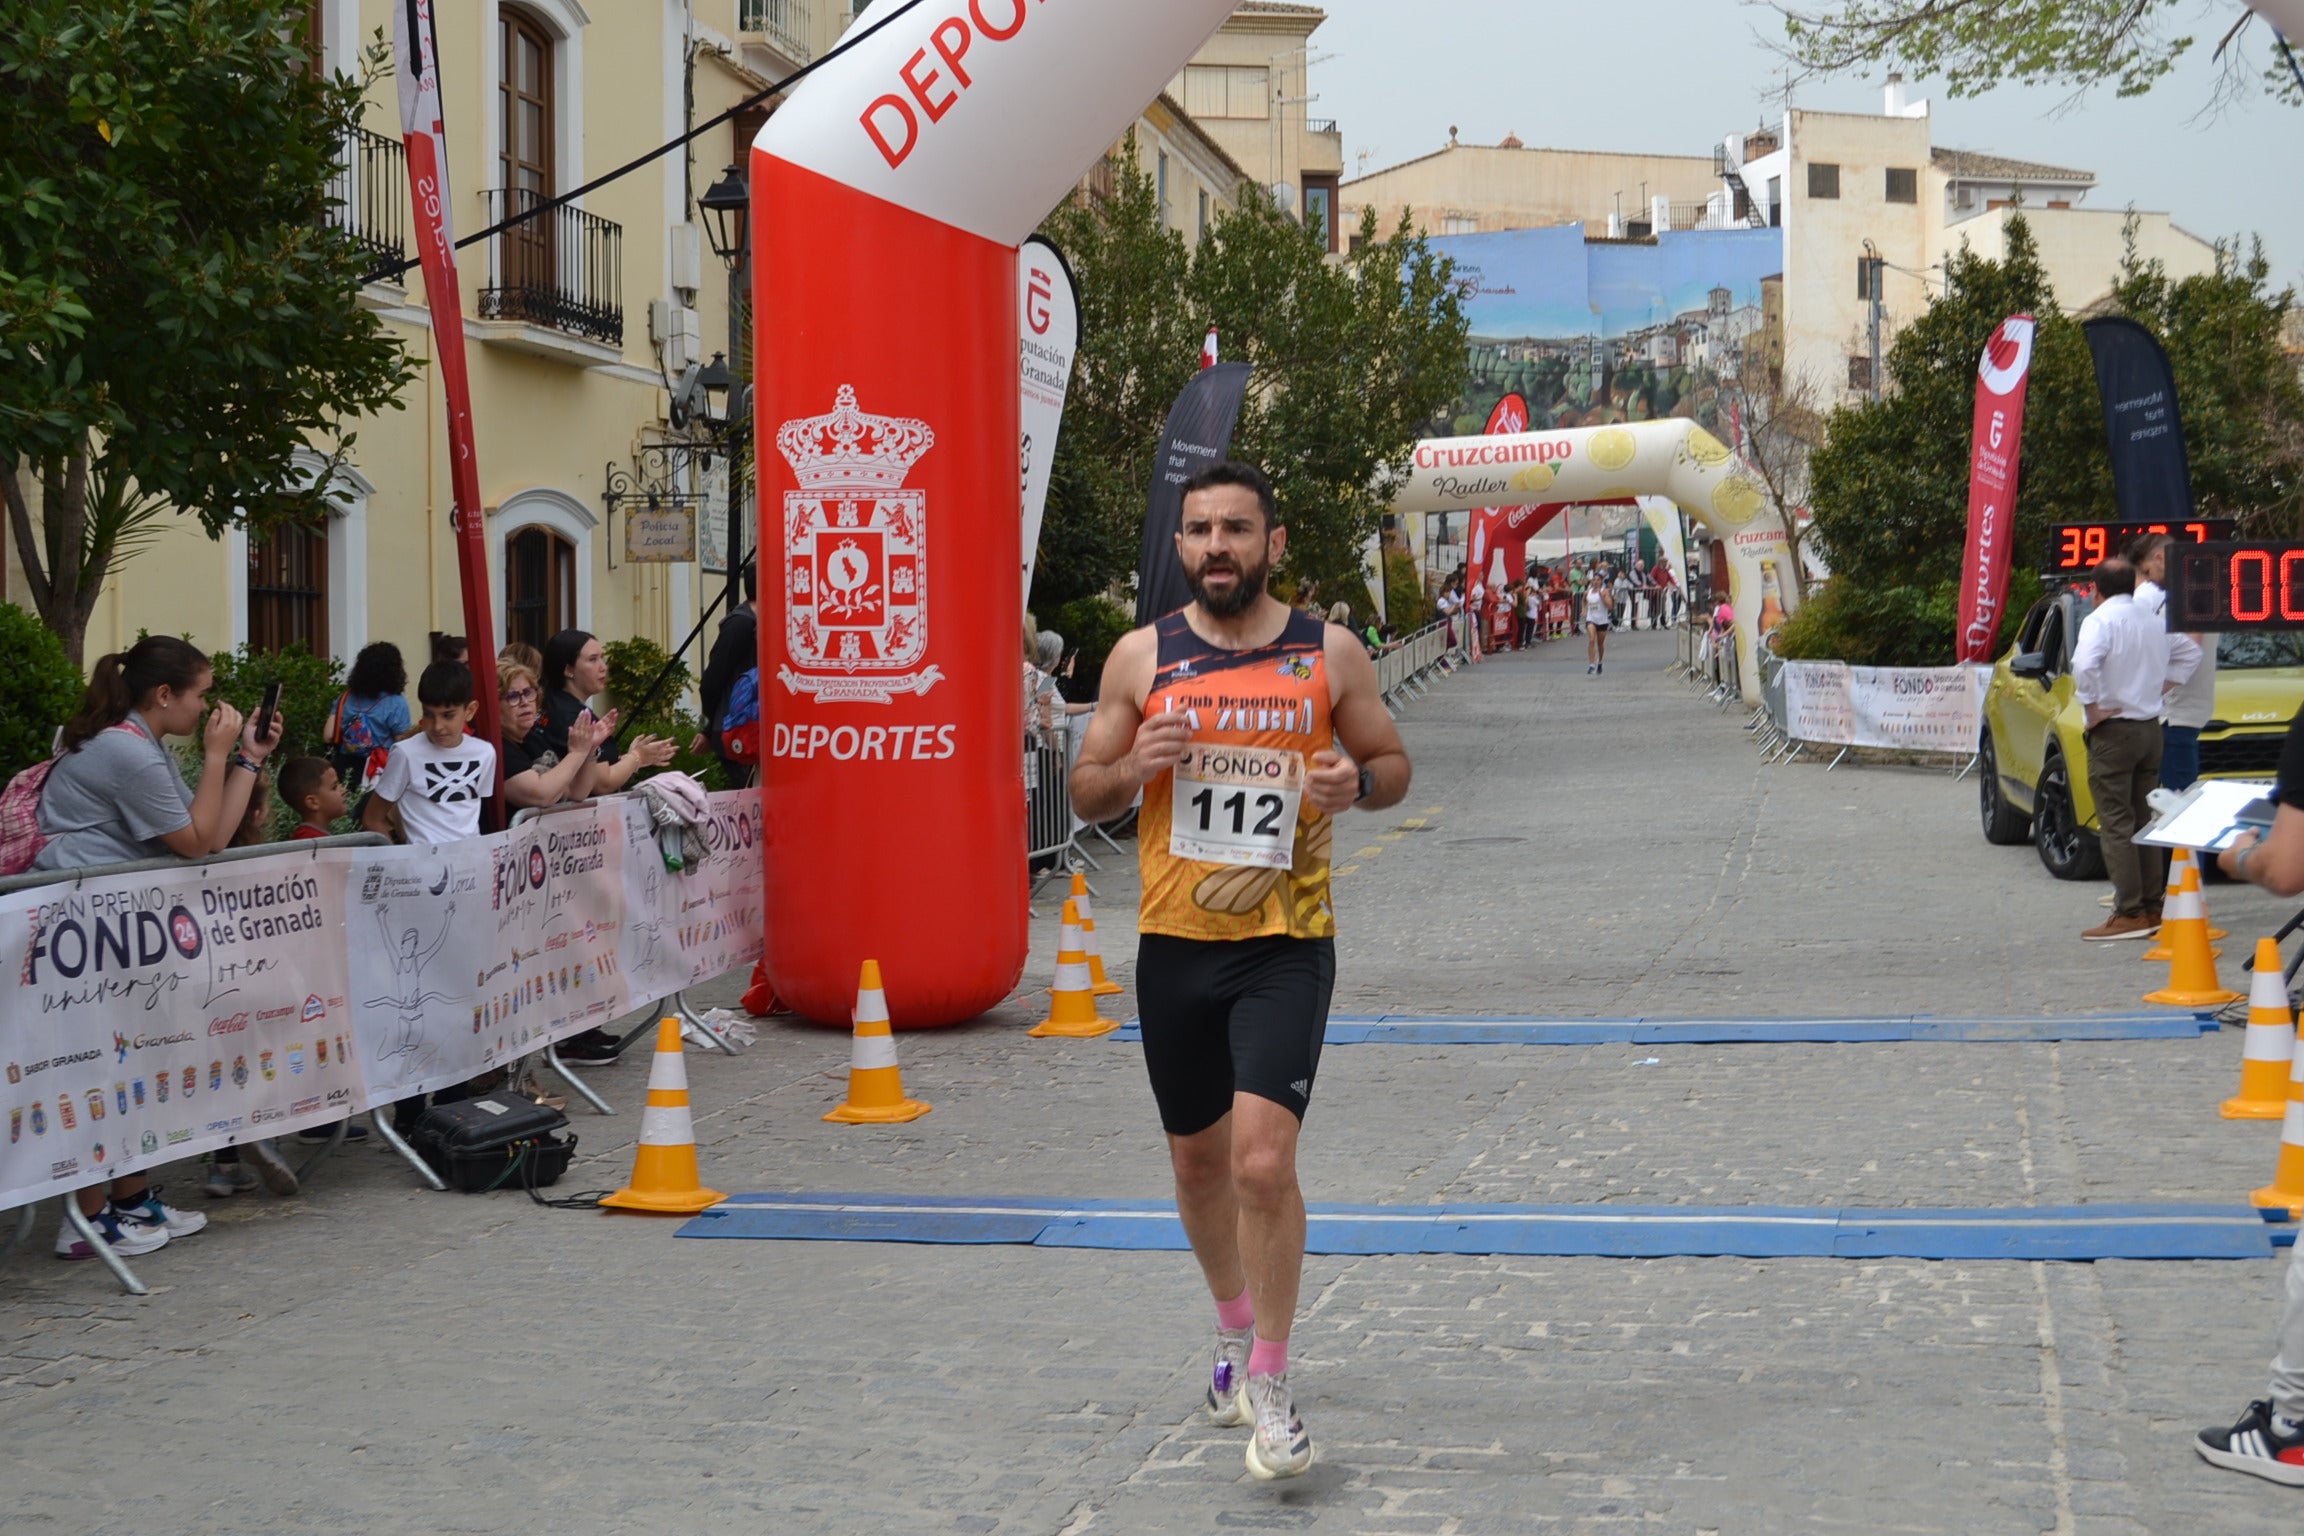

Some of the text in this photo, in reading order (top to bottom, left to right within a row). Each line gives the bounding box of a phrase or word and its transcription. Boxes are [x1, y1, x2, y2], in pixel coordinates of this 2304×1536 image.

[859, 0, 1047, 170] DEPO
[1020, 356, 1065, 392] Granada
[1168, 454, 1186, 468] that
[1170, 438, 1217, 458] Movement
[1415, 439, 1573, 470] Cruzcampo
[1432, 476, 1509, 500] Radler
[643, 536, 675, 549] Local
[2060, 527, 2107, 567] 39
[822, 686, 881, 698] GRANADA
[1179, 695, 1298, 710] Club Deportivo
[1215, 696, 1314, 735] ZUBIA
[772, 722, 957, 761] DEPORTES
[1202, 755, 1281, 778] FONDO
[1191, 787, 1284, 838] 112
[36, 895, 85, 927] GRAN
[91, 886, 165, 917] PREMIO
[201, 872, 319, 920] Diputación
[174, 922, 197, 943] 24
[211, 903, 323, 946] de Granada
[28, 905, 203, 986] FONDO
[42, 971, 189, 1014] universo
[133, 1030, 196, 1050] Granada
[51, 1048, 103, 1068] GRANADA
